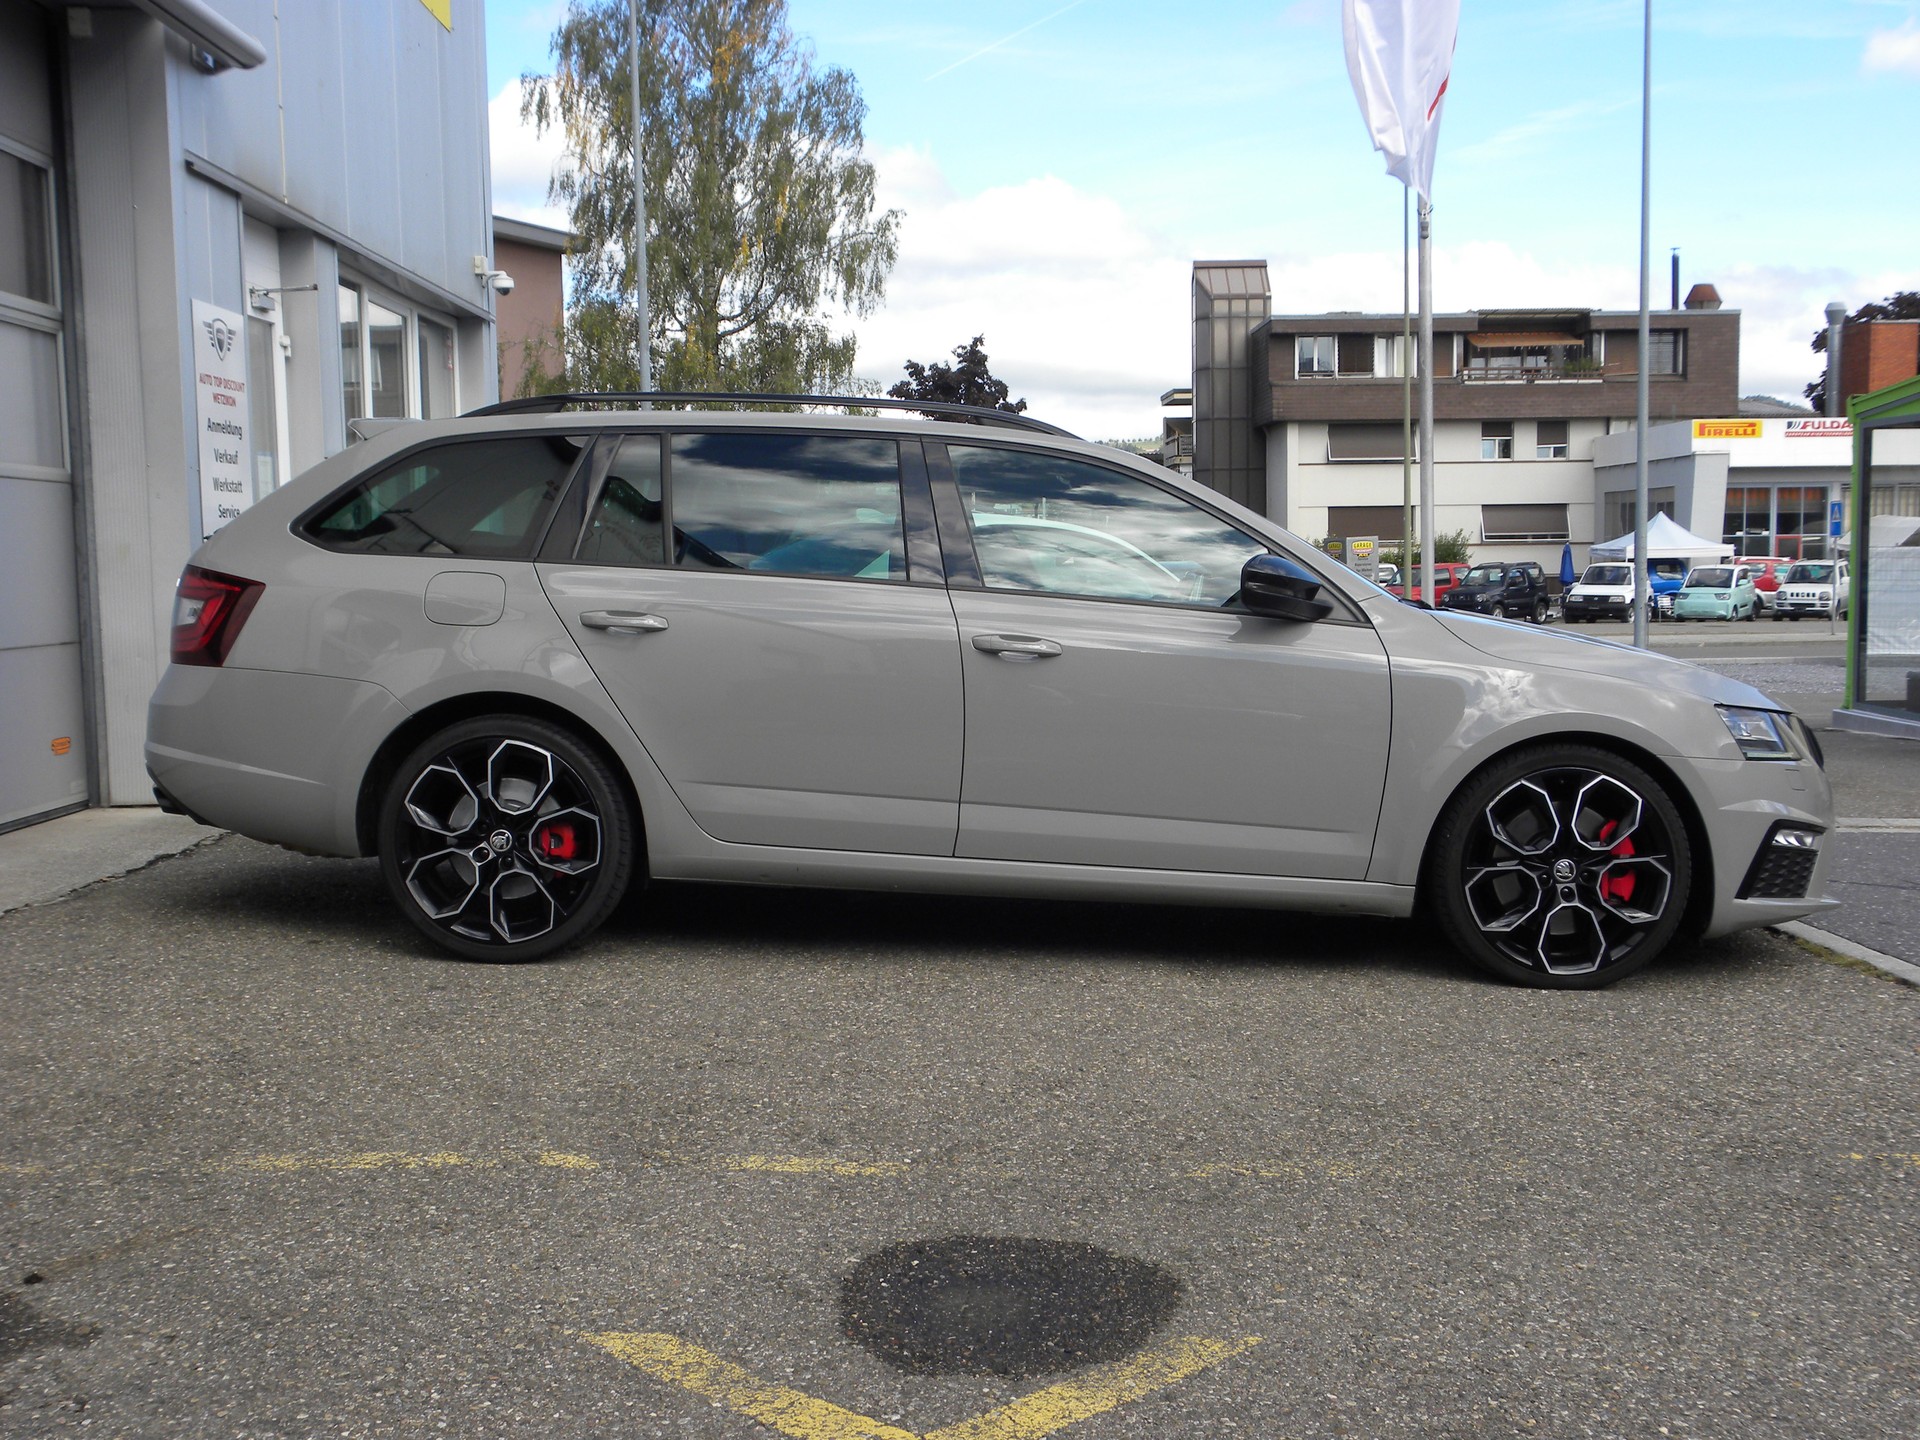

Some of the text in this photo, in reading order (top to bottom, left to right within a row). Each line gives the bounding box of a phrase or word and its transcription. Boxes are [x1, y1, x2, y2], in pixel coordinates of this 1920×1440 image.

[199, 373, 245, 392] AUTO TOP DISCOUNT
[213, 392, 236, 407] WETZIKON
[207, 417, 242, 440] Anmeldung
[1699, 423, 1757, 436] PIRELLI
[1800, 420, 1853, 430] FULDA
[214, 447, 239, 465] Verkauf
[212, 476, 243, 494] Werkstatt
[218, 503, 241, 519] Service
